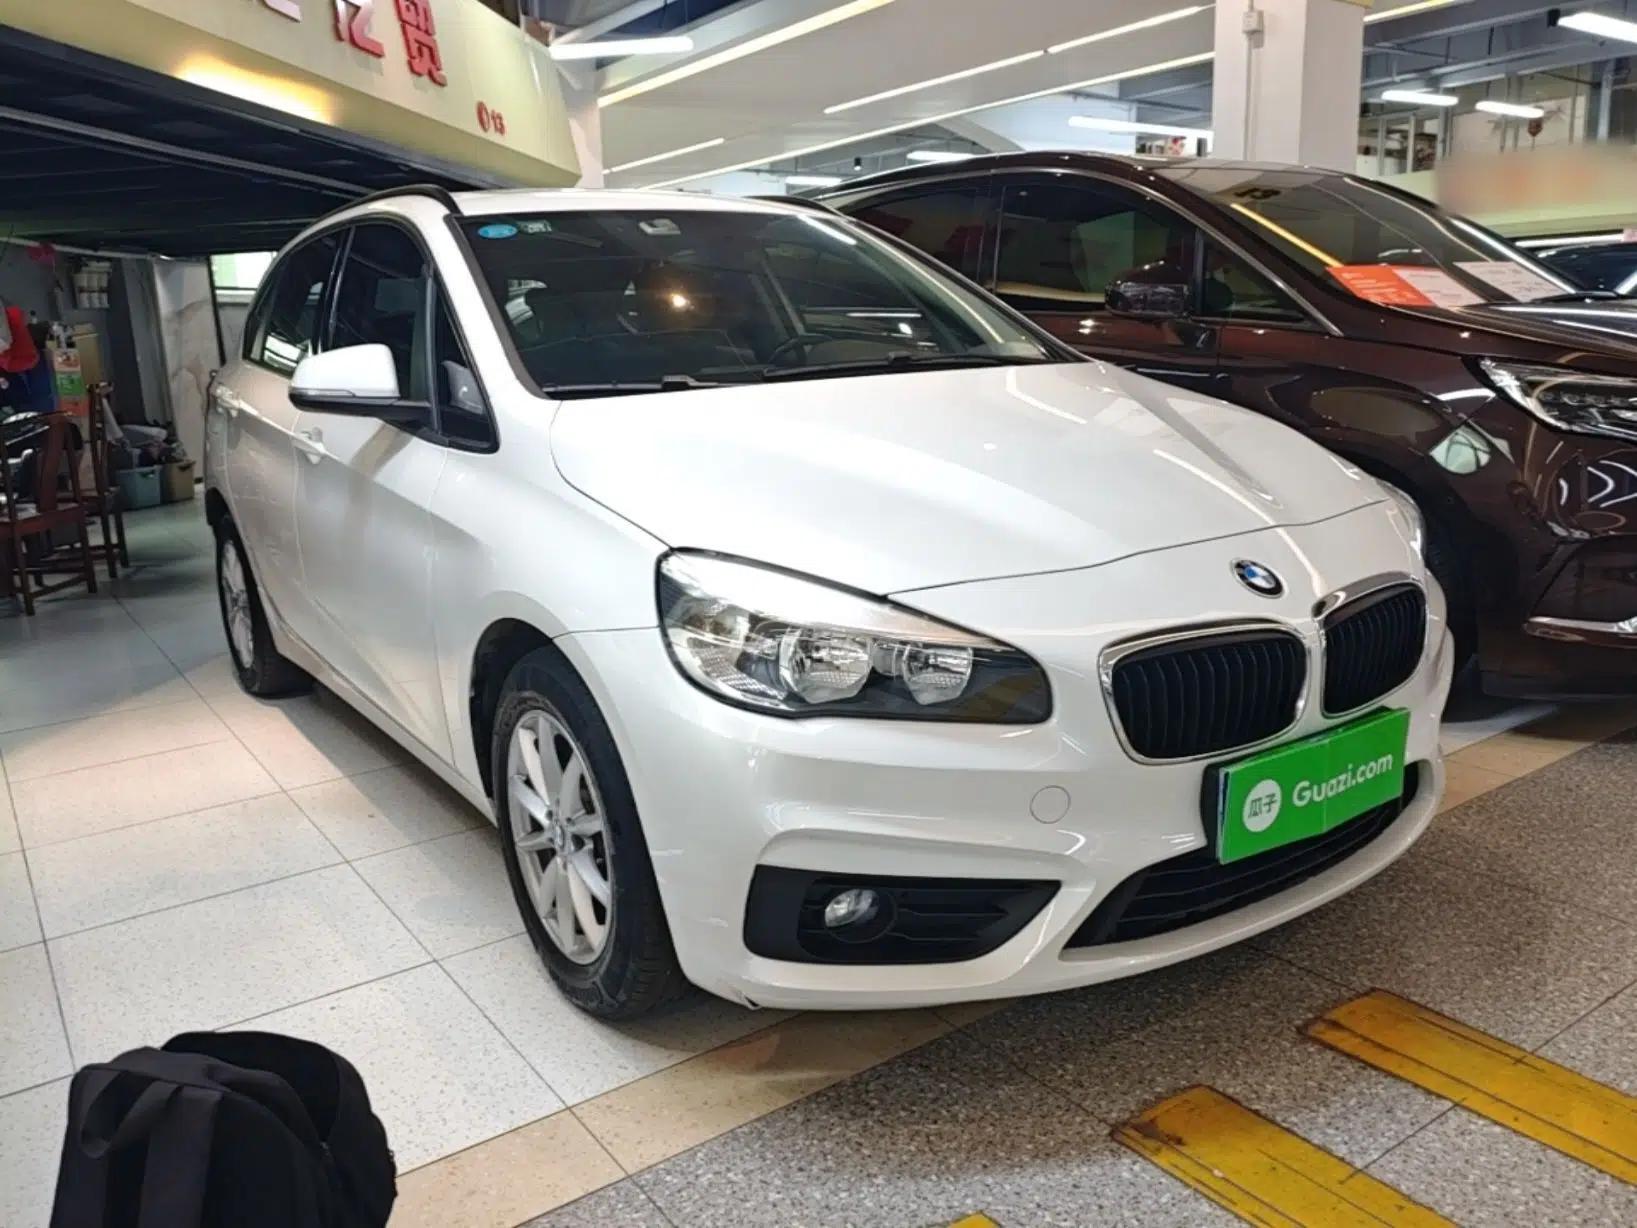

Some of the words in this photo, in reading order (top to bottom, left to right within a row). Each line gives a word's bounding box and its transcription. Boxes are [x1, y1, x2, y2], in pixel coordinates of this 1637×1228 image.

[263, 0, 448, 87] 亿贸
[1247, 788, 1279, 819] 瓜子
[1292, 753, 1393, 808] Guazi.com
